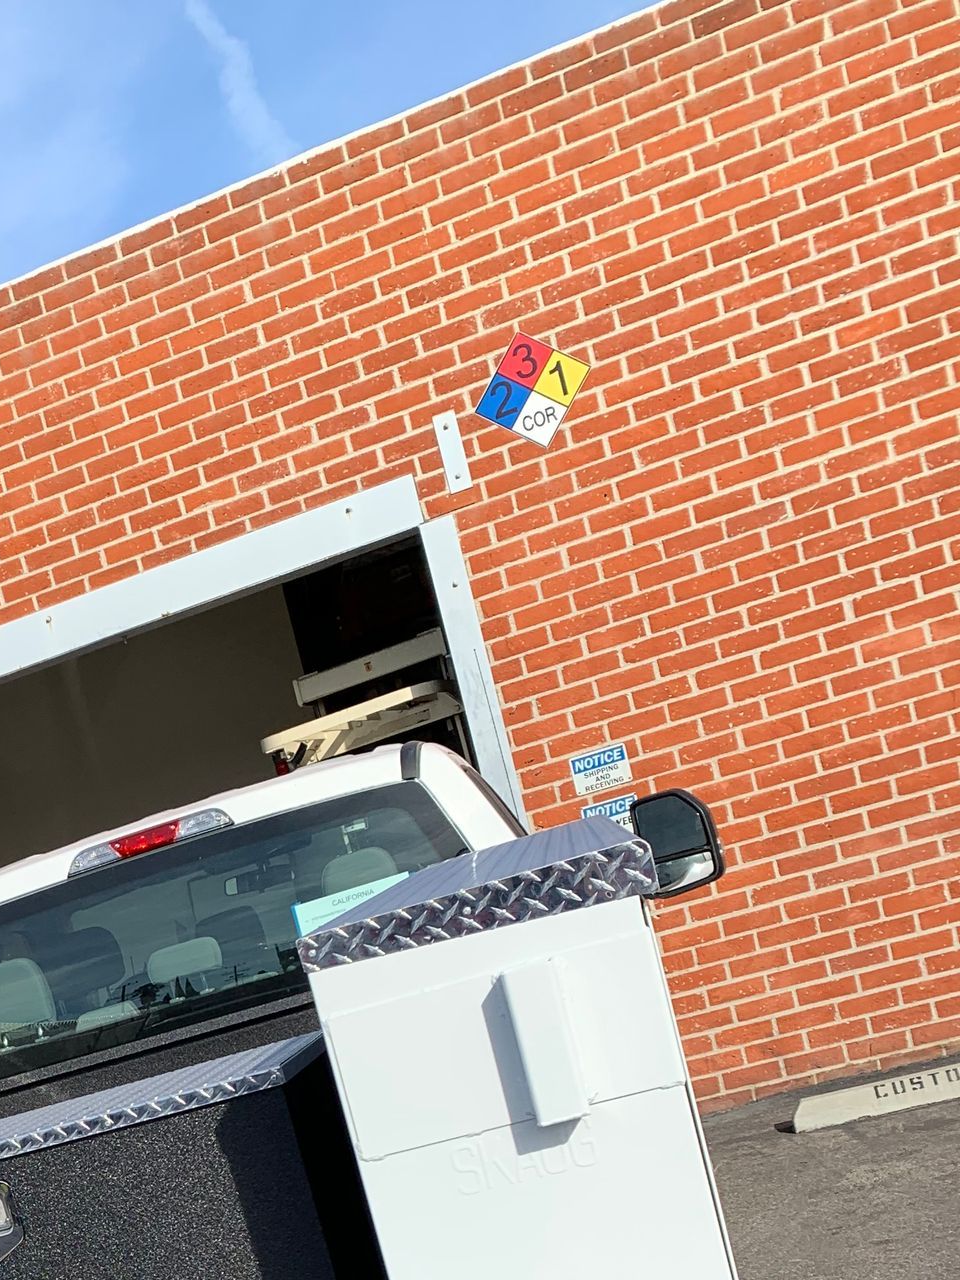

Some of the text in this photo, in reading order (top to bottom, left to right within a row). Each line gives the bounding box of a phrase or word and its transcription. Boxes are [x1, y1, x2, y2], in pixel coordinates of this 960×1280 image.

[512, 343, 538, 379] 3
[548, 359, 569, 396] 1
[490, 380, 518, 420] 2
[522, 406, 558, 432] COR
[575, 747, 622, 773] NOTICE
[583, 763, 619, 780] SHIPPING
[585, 776, 624, 793] RECEIVING
[595, 773, 611, 783] AND
[585, 797, 634, 818] NOTICE
[331, 888, 375, 907] CALIFORNIA
[449, 1135, 599, 1197] SKAUG
